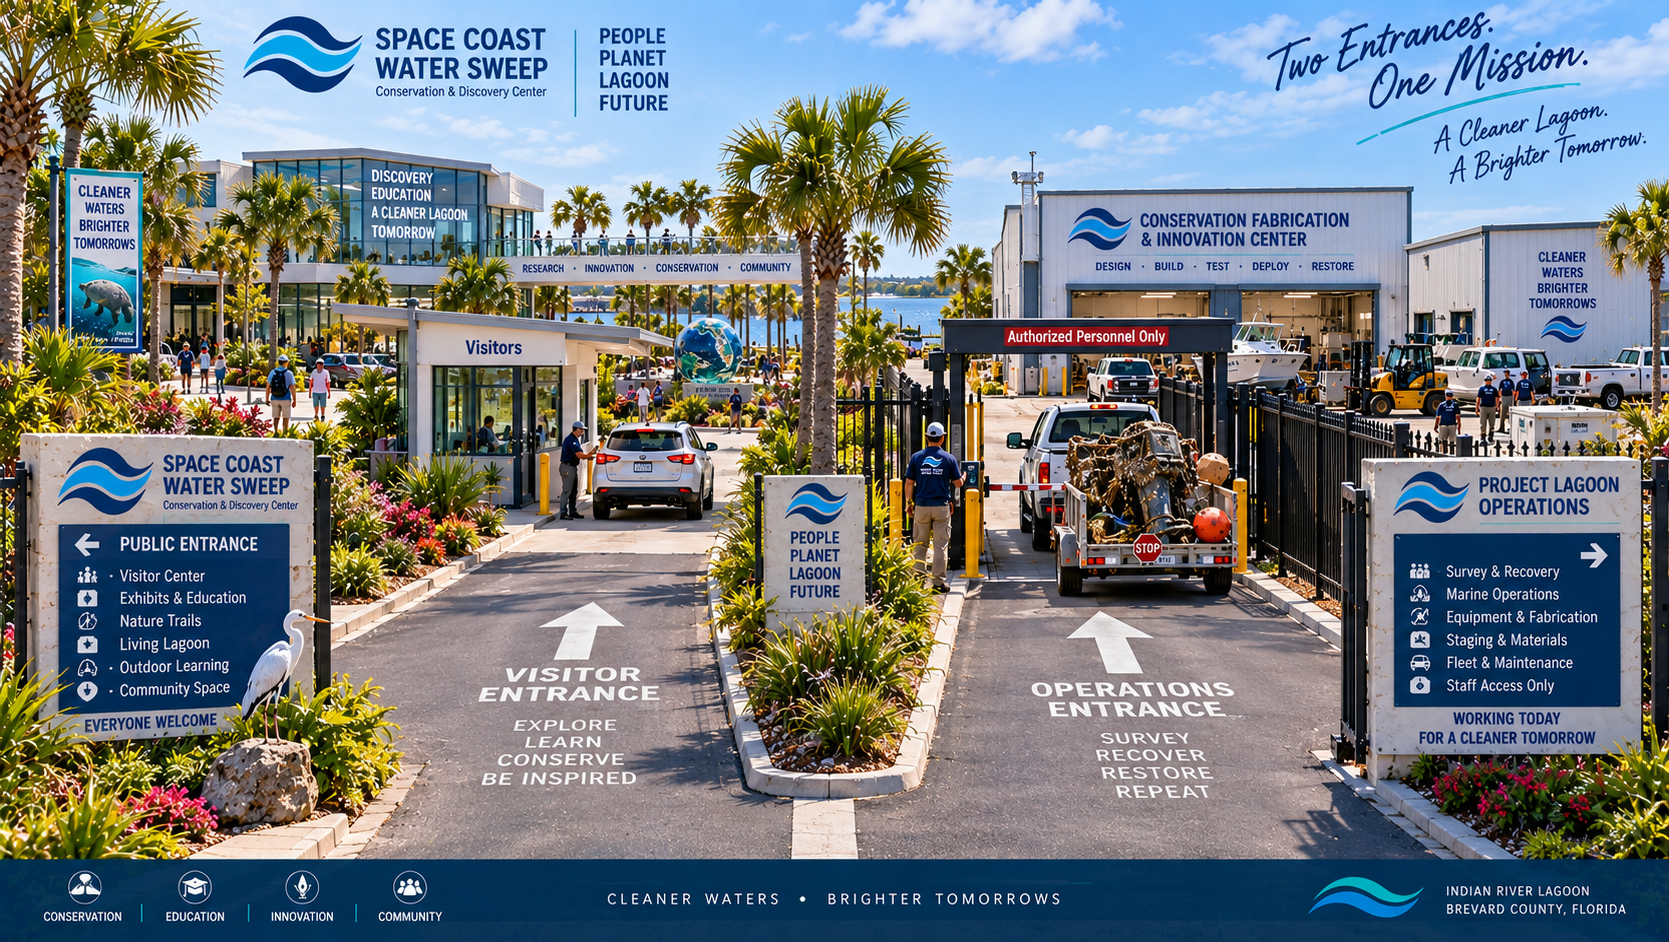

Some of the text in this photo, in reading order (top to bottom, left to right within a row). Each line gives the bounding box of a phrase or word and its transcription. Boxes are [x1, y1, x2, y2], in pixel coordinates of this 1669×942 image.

[371, 168, 434, 185] DISCOVERY
[78, 184, 131, 200] CLEANER
[371, 186, 432, 202] EDUCATION
[84, 201, 125, 215] WATERS
[371, 205, 468, 222] A CLEANER LAGOON
[79, 218, 130, 233] BRIGHTER
[1140, 212, 1350, 228] CONSERVATION FABRICATION
[371, 224, 436, 240] TOMORROW
[1141, 231, 1307, 247] & INNOVATION CENTER
[73, 236, 136, 251] TOMORROWS
[1538, 251, 1587, 263] CLEANER
[522, 262, 792, 274] RESEARCH INNOVATION CONSERVATION COMMUNITY
[1095, 261, 1355, 271] DESIGN BUILD TEST DEPLOY RESTORE
[1541, 266, 1584, 278] WATERS
[1537, 282, 1588, 294] BRIGHTER
[1528, 297, 1597, 309] TOMORROWS
[1007, 329, 1166, 346] Authorized Personnel Only
[465, 339, 523, 355] Visitors
[163, 454, 285, 474] SPACE COAST
[162, 476, 290, 495] WATER SWEEP
[1479, 476, 1620, 494] PROJECT LAGOON
[162, 499, 299, 512] Conservation & Discovery Center
[1478, 497, 1590, 516] OPERATIONS
[120, 536, 258, 552] PUBLIC ENTRANCE
[790, 530, 840, 545] PEOPLE
[790, 548, 841, 563] PLANET
[1135, 542, 1161, 554] STOP
[119, 568, 206, 583] Visitor Center
[789, 566, 841, 581] LAGOON
[1446, 564, 1560, 581] Survey & Recovery
[120, 590, 247, 605] Exhibits & Education
[790, 584, 841, 599] FUTURE
[1446, 587, 1560, 603] Marine Operations
[120, 613, 202, 628] Nature Trails
[1446, 610, 1598, 627] Equipment & Fabrication
[120, 637, 210, 654] Living Lagoon
[1446, 632, 1568, 650] Staging & Materials
[119, 658, 230, 674] Outdoor Learning
[1447, 655, 1574, 669] Fleet & Maintenance
[505, 666, 641, 683] VISITOR
[119, 681, 231, 698] Community Space
[478, 685, 661, 703] ENTRANCE
[1031, 681, 1235, 697] OPERATIONS
[1446, 678, 1555, 695] Staff Access Only
[1048, 701, 1227, 718] ENTRANCE
[84, 712, 218, 733] EVERYONE WELCOME
[513, 719, 617, 732] EXPLORE
[1452, 711, 1561, 726] WORKING TODAY
[524, 735, 601, 749] LEARN
[1100, 732, 1189, 745] SURVEY
[1419, 731, 1596, 745] FOR A CLEANER TOMORROW
[497, 752, 625, 767] CONSERVE
[1095, 749, 1207, 762] RECOVER
[481, 771, 637, 786] BE INSPIRED
[1100, 766, 1214, 780] RESTORE
[1115, 785, 1209, 799] REPEAT
